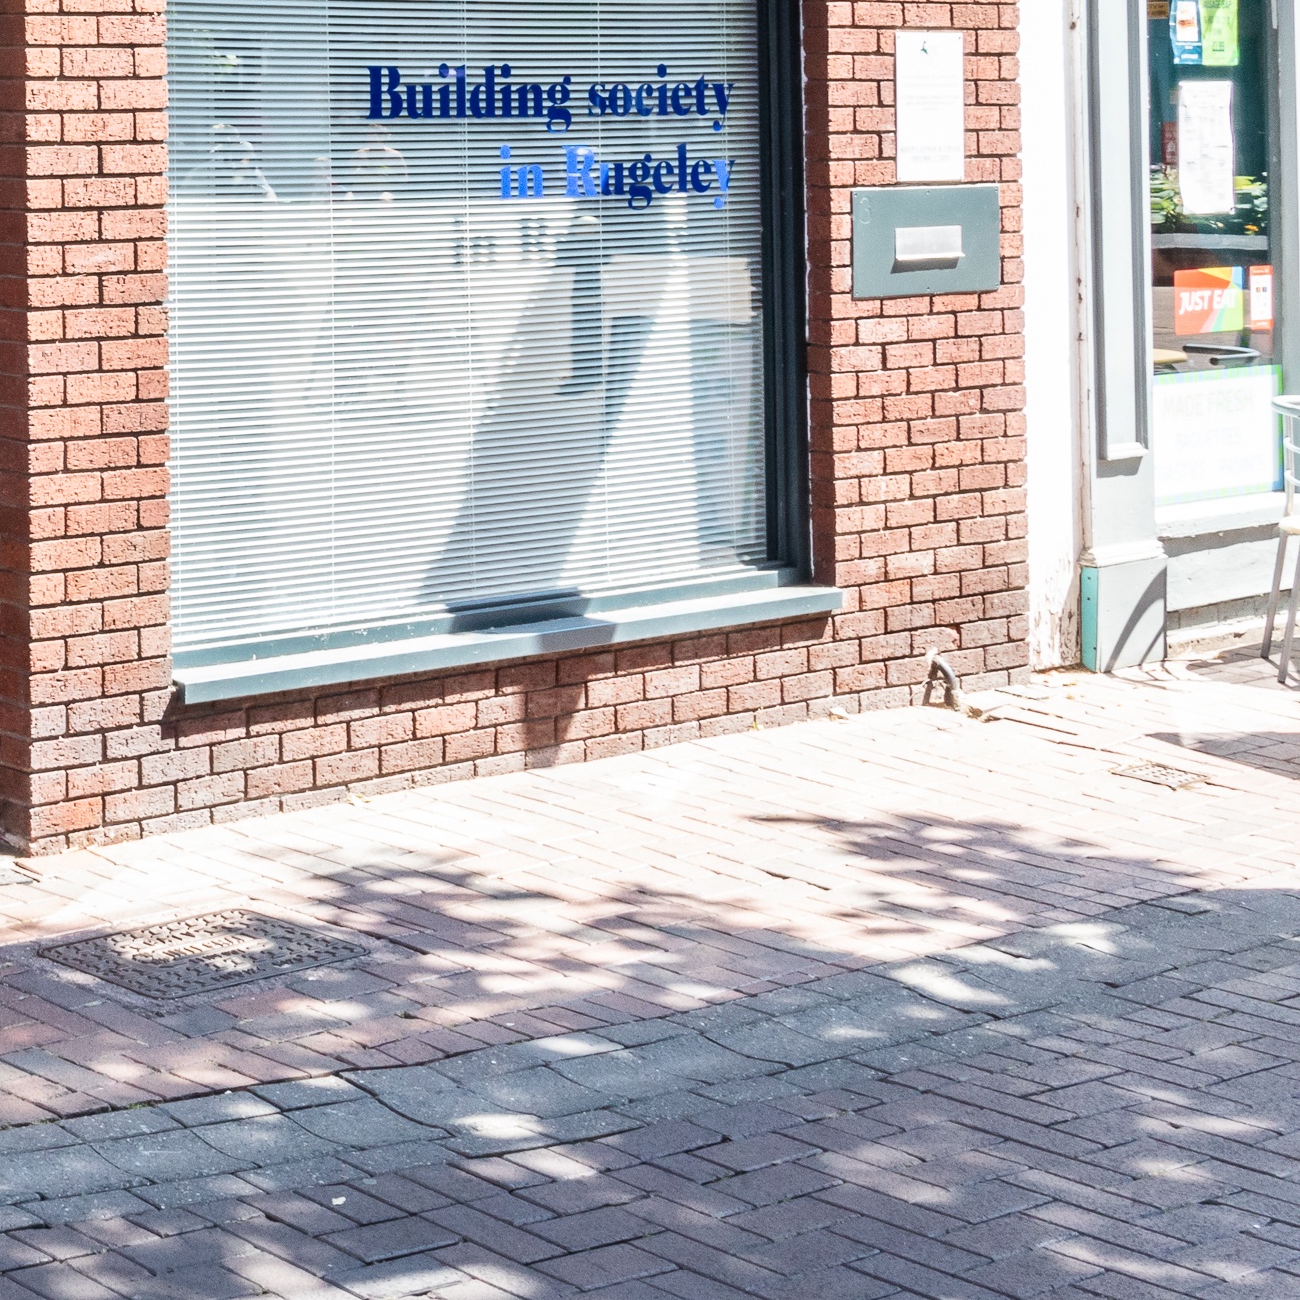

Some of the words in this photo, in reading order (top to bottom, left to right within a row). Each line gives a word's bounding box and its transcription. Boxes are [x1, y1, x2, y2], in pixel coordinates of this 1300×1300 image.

[365, 62, 572, 133] Building
[587, 63, 735, 132] society
[500, 144, 545, 199] in
[562, 142, 736, 210] Rugeley
[1179, 290, 1212, 315] JUST
[1213, 289, 1238, 310] EAT
